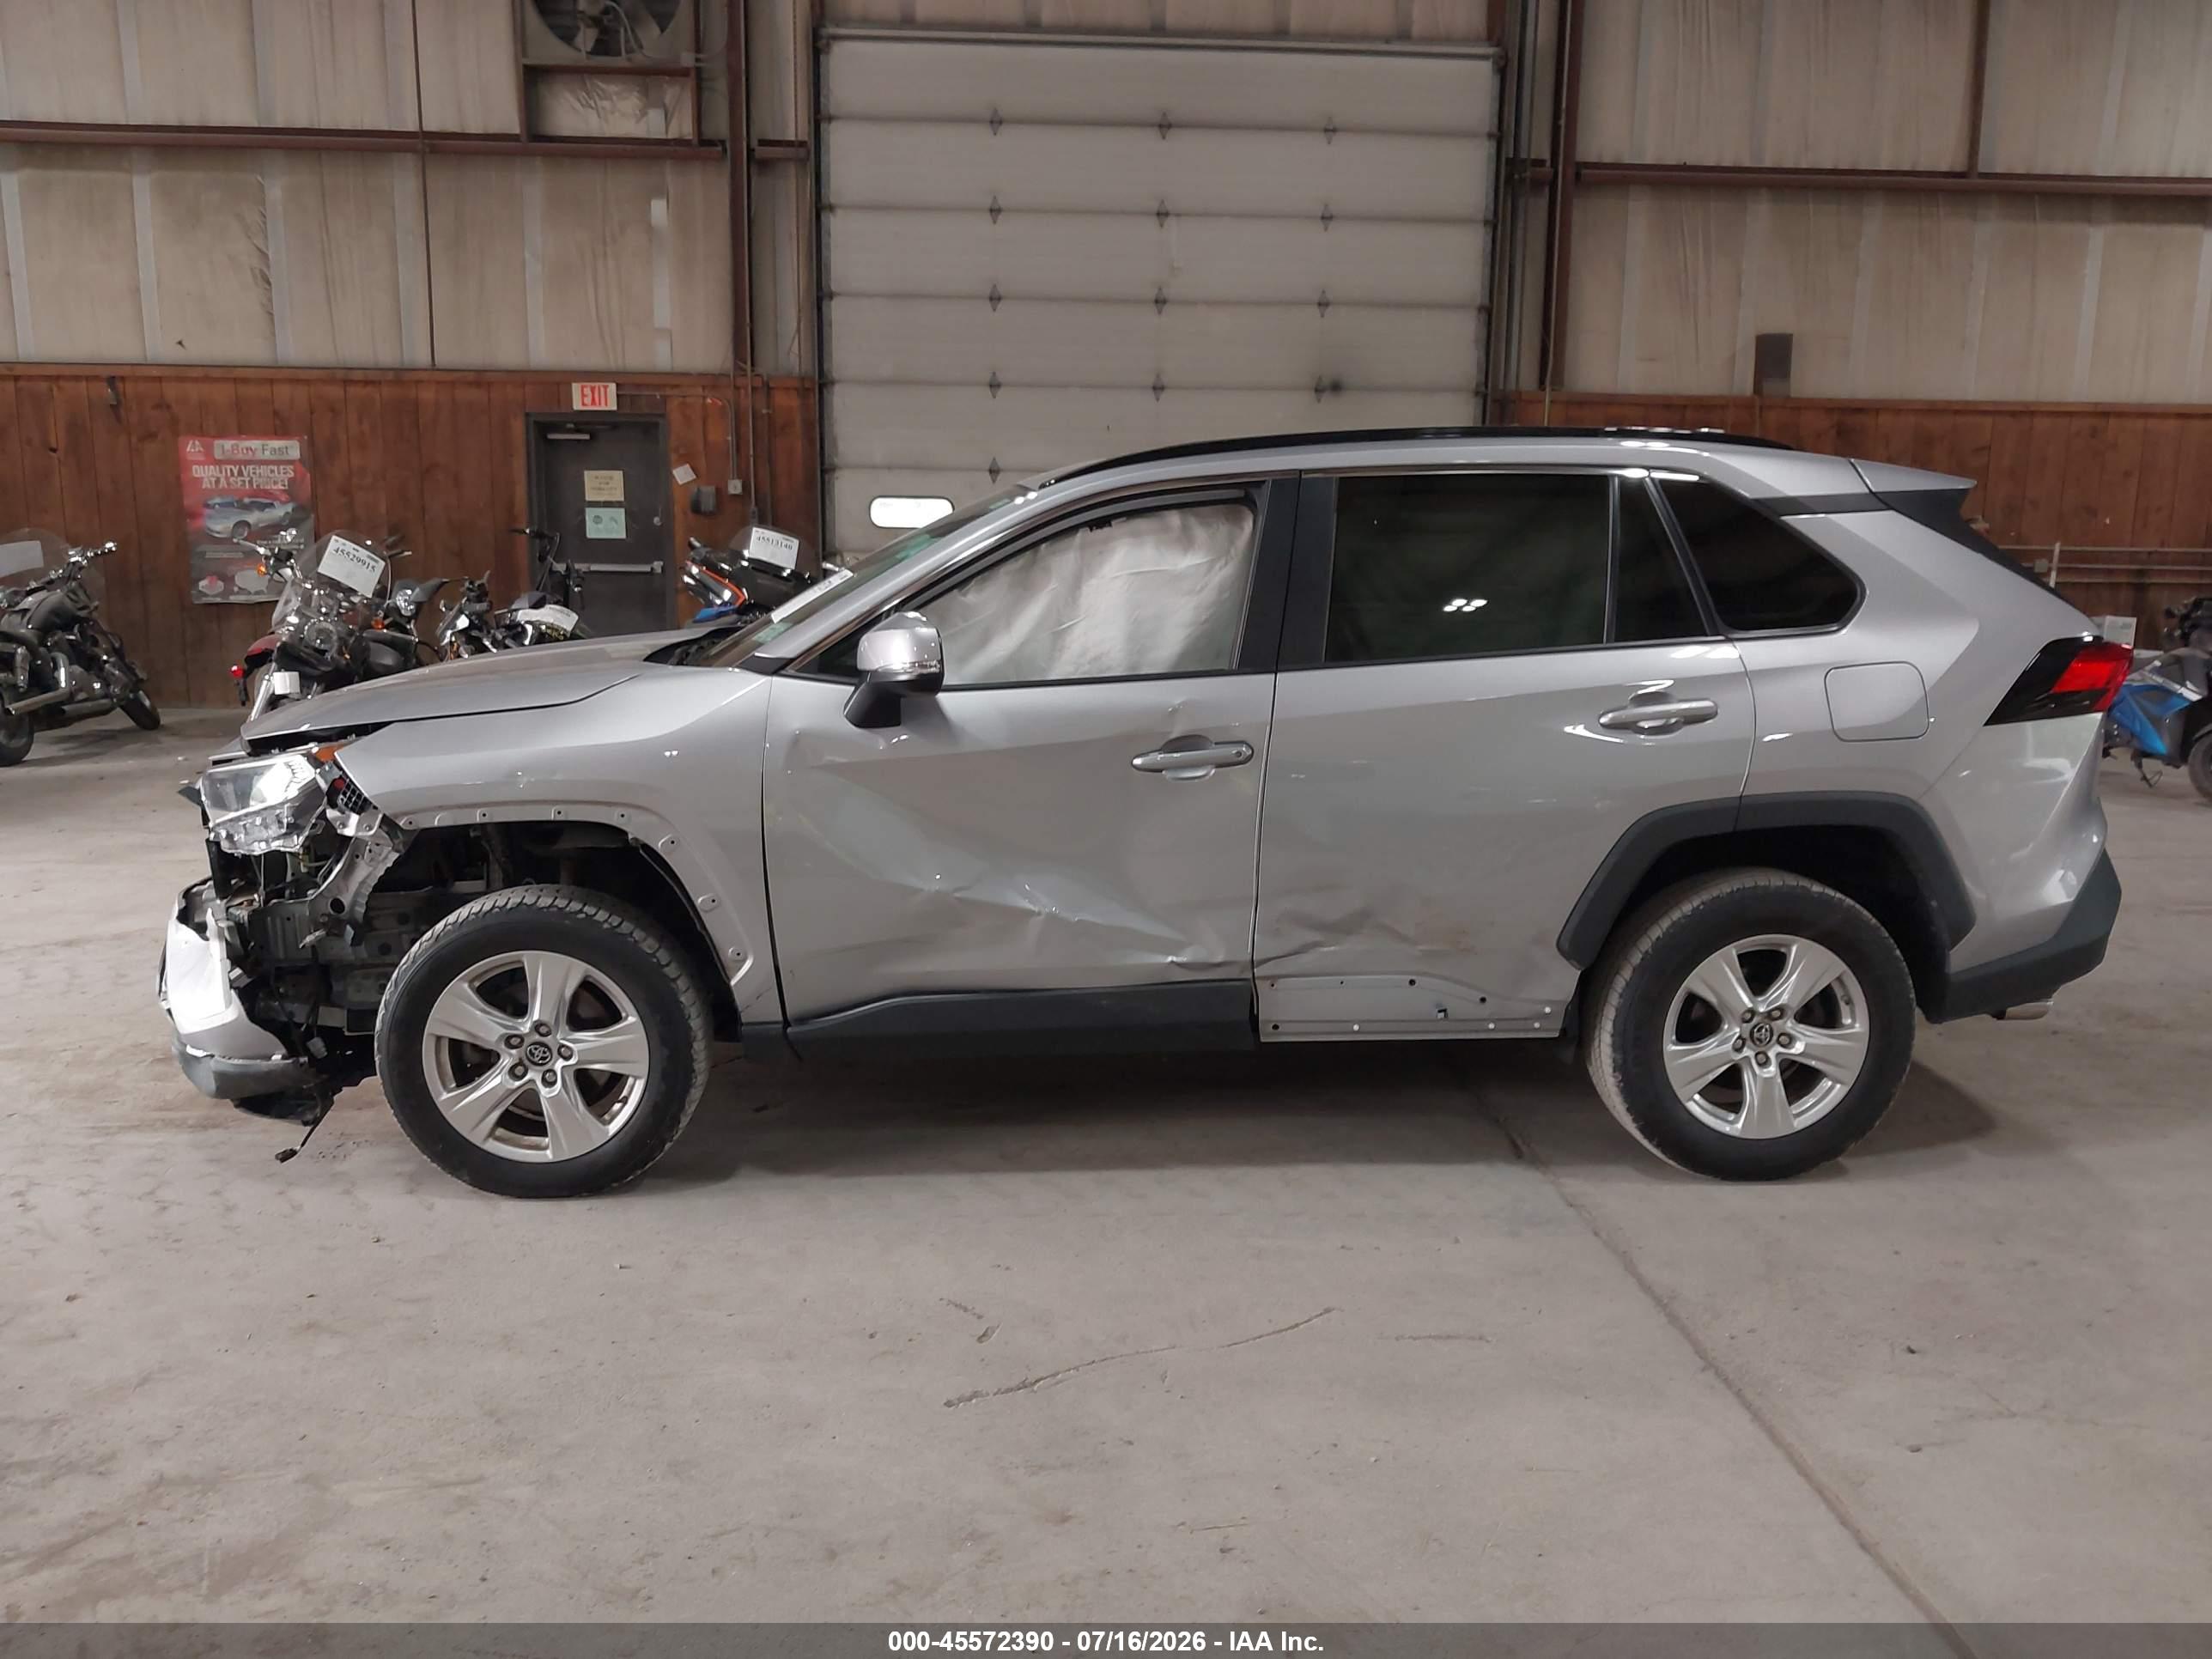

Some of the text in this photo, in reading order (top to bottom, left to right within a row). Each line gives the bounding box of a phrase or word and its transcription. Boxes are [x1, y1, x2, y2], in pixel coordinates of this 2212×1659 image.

[580, 385, 609, 407] EXIT
[261, 444, 289, 456] Fast
[192, 465, 295, 477] QUALITY VEHICLES
[202, 477, 217, 489] AT
[218, 477, 228, 489] A
[229, 477, 251, 489] SET
[332, 546, 377, 573] 45529915
